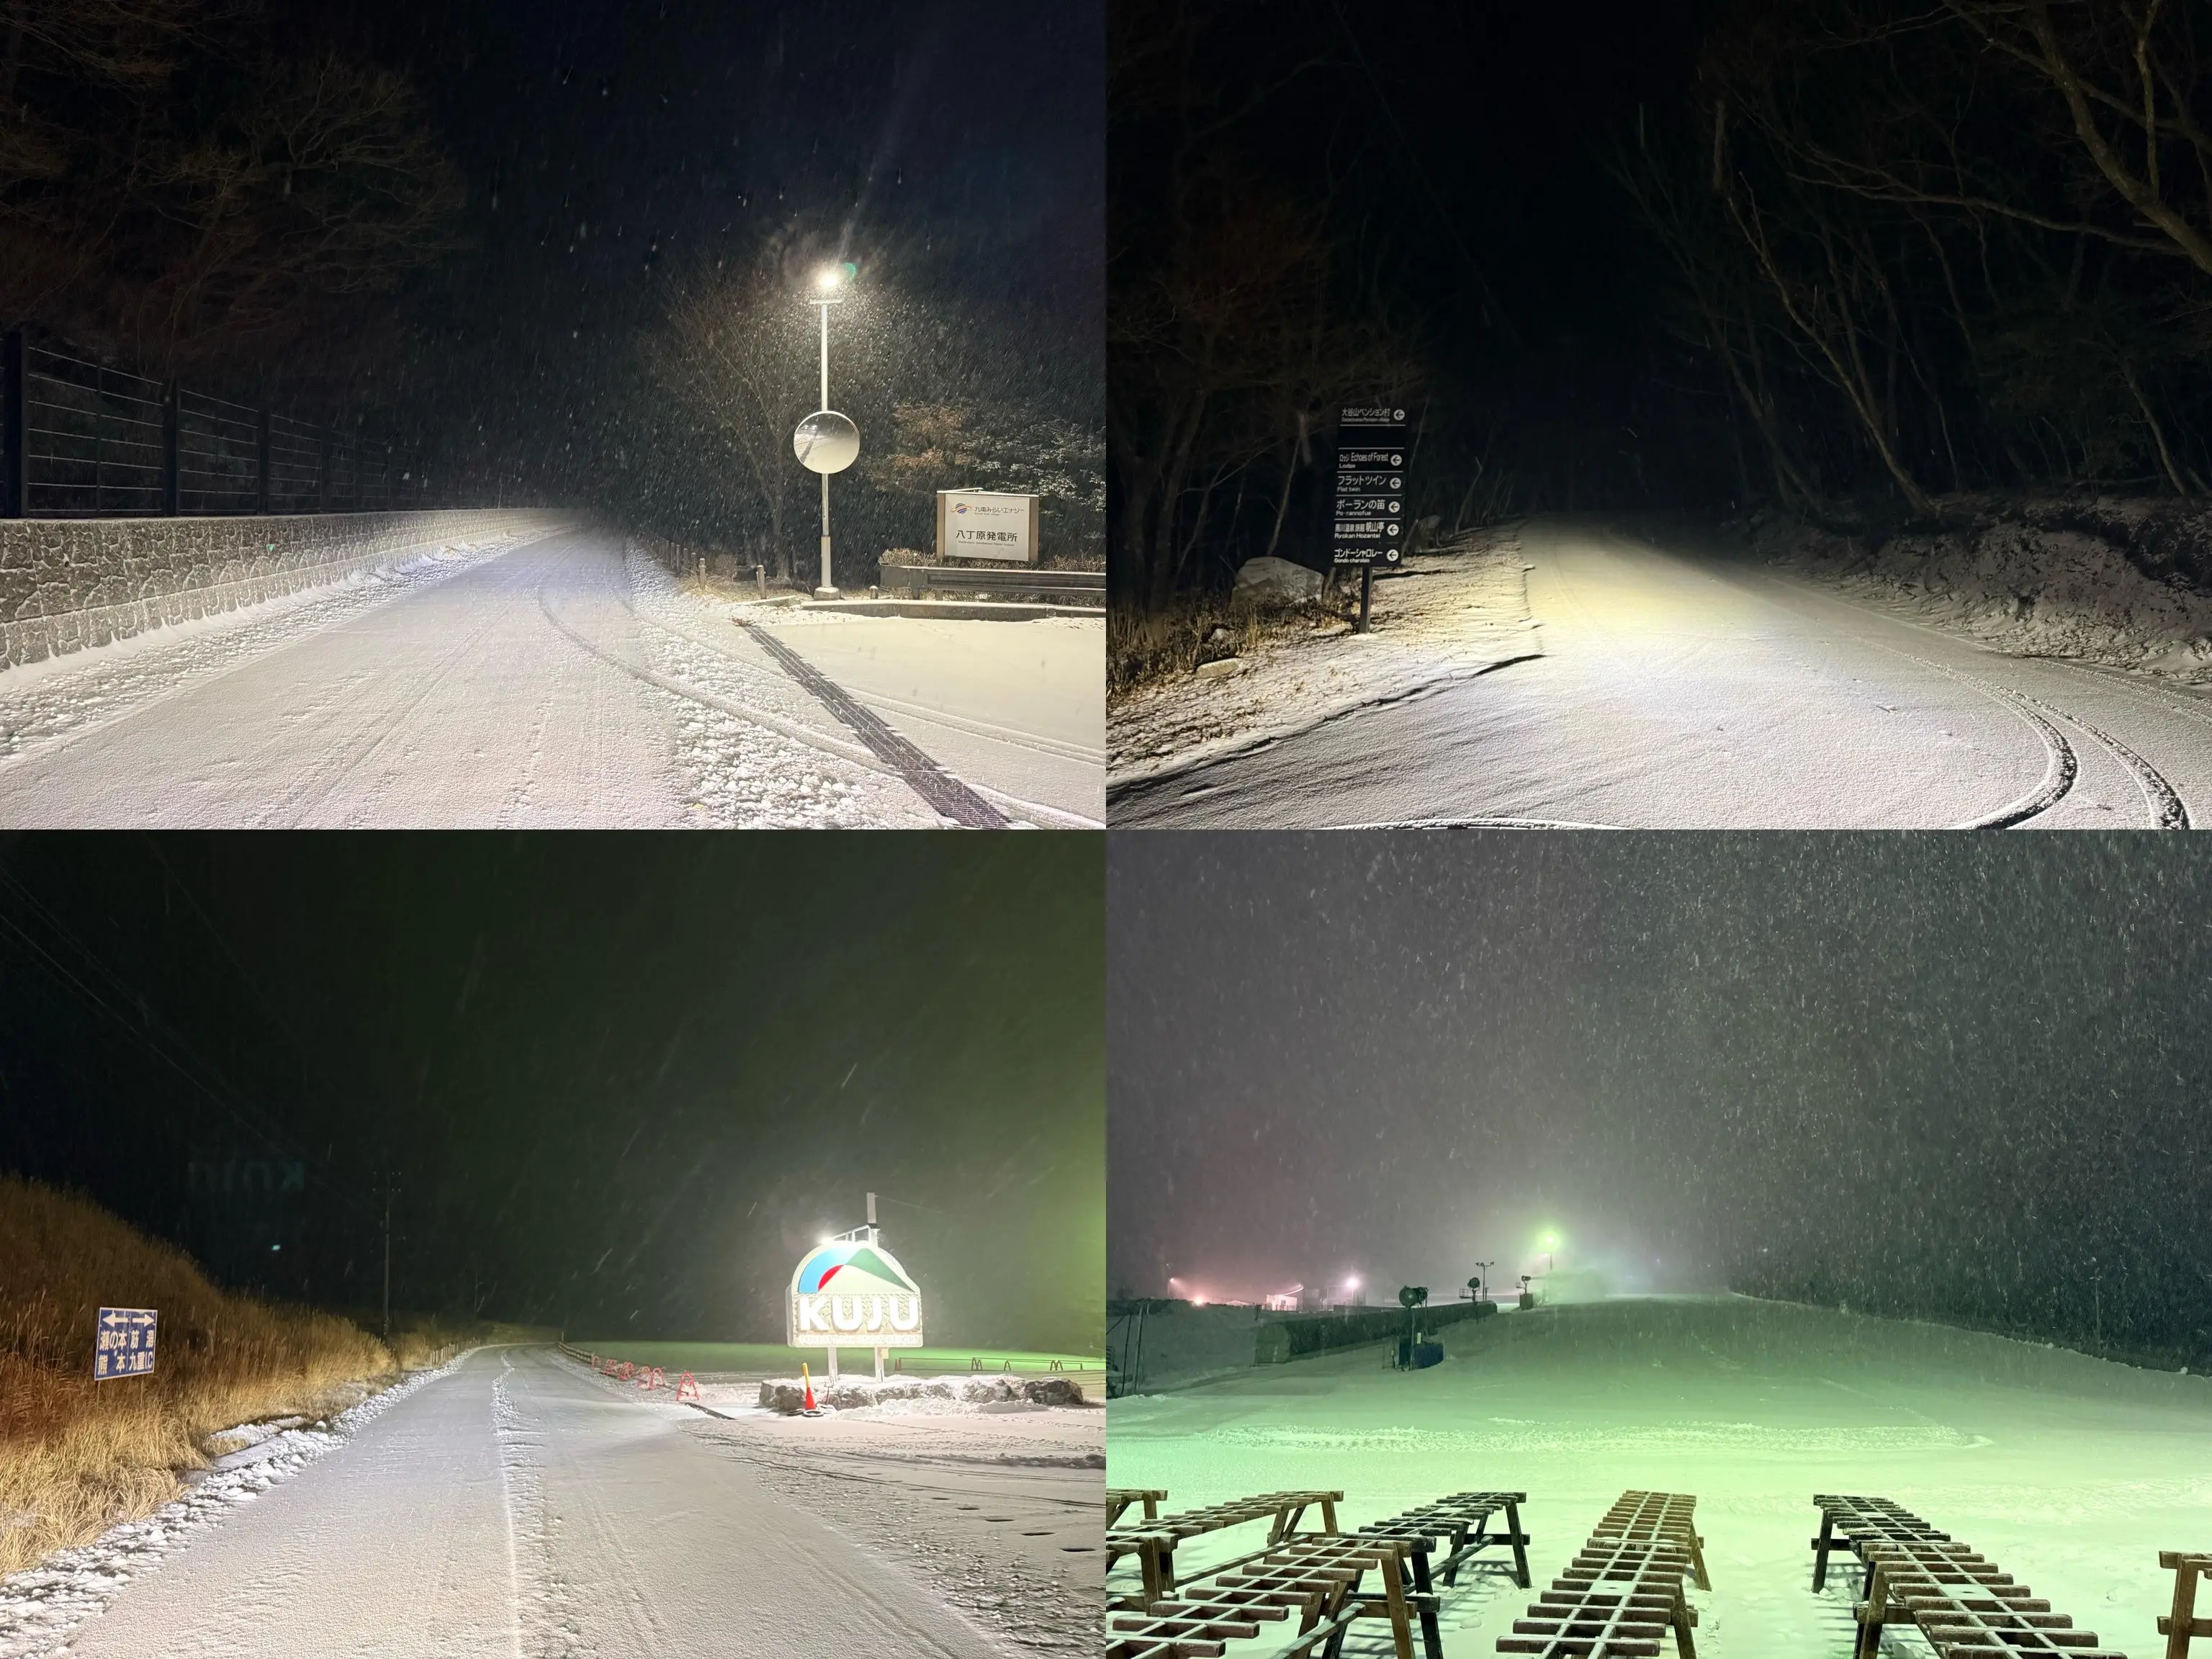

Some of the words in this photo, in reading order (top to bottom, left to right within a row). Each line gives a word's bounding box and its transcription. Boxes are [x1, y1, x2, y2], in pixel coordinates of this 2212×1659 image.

[1351, 452, 1367, 462] Echoes
[1368, 452, 1373, 462] of
[1374, 452, 1388, 462] Forest
[1338, 475, 1387, 485] フラットツイン
[956, 530, 1017, 542] 八丁原発電所
[1334, 548, 1382, 557] ゴンドーシャロレー
[799, 1297, 919, 1331] KUJU
